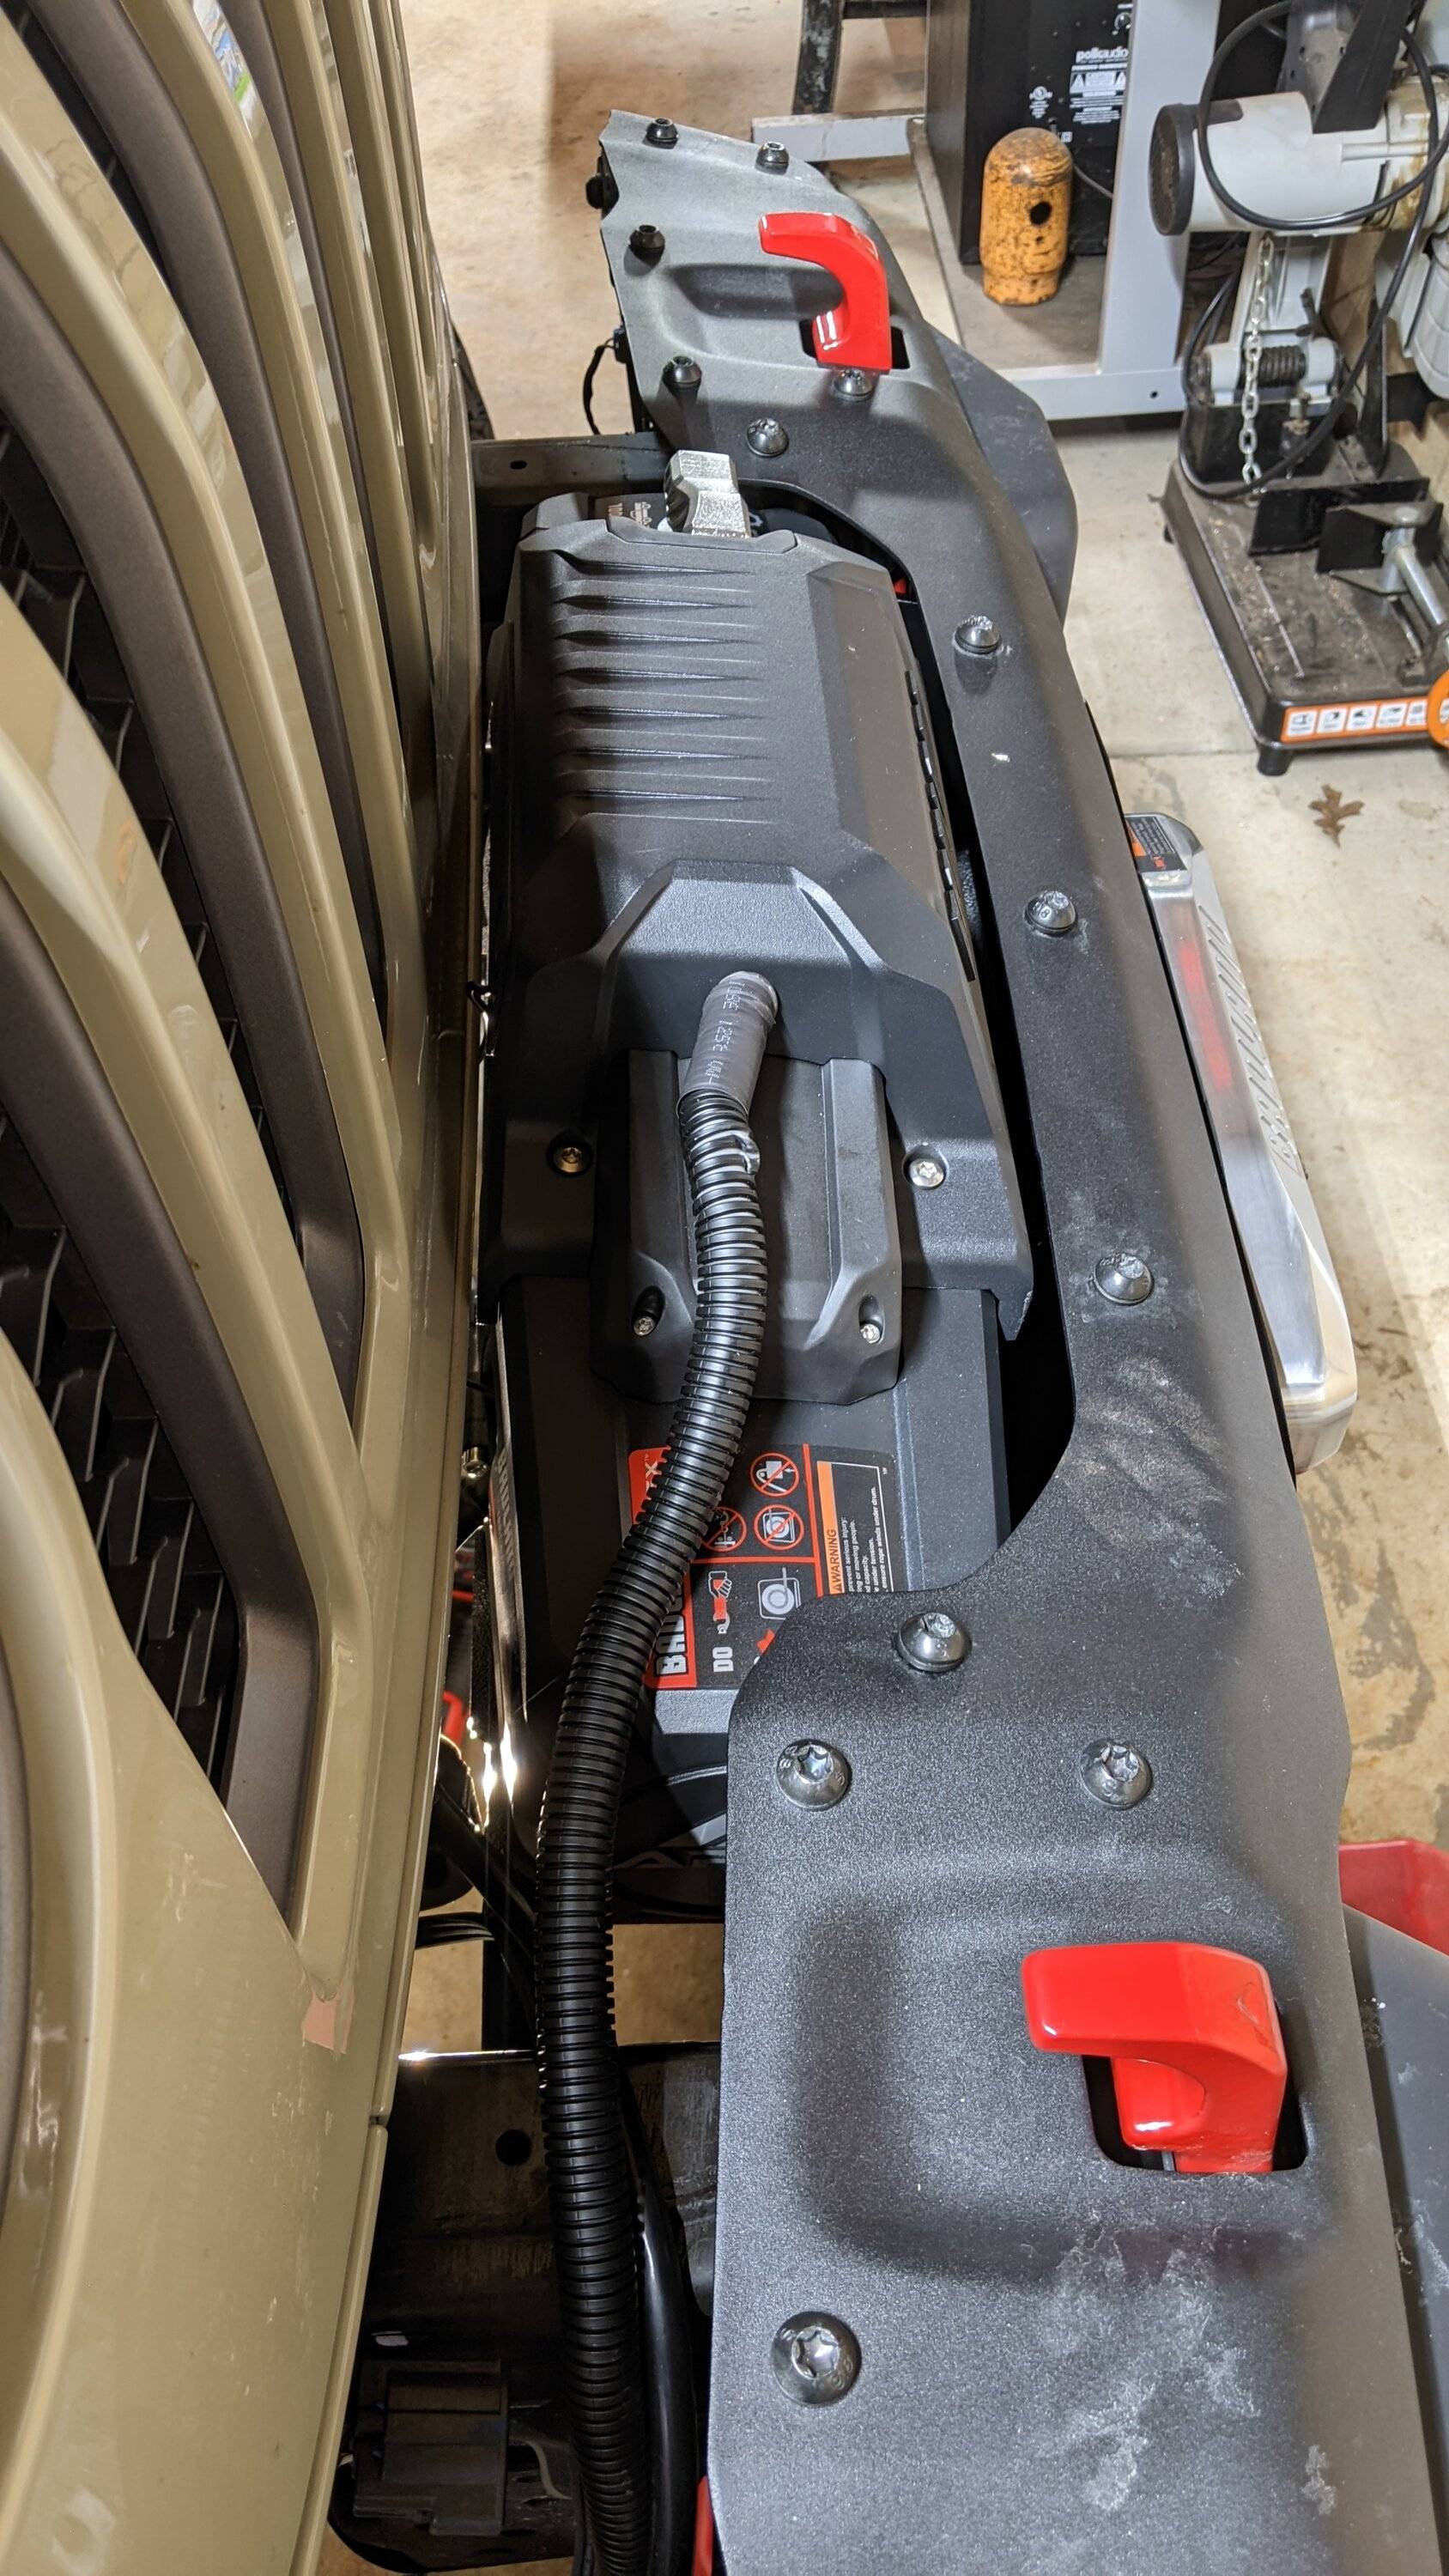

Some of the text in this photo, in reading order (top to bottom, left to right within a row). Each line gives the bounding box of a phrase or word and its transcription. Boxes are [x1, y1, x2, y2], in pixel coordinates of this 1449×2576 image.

[827, 1528, 842, 1585] WARNING
[862, 1554, 871, 1584] capacity.
[877, 1548, 886, 1564] rope
[846, 1565, 855, 1592] prevent
[712, 1646, 734, 1673] DO
